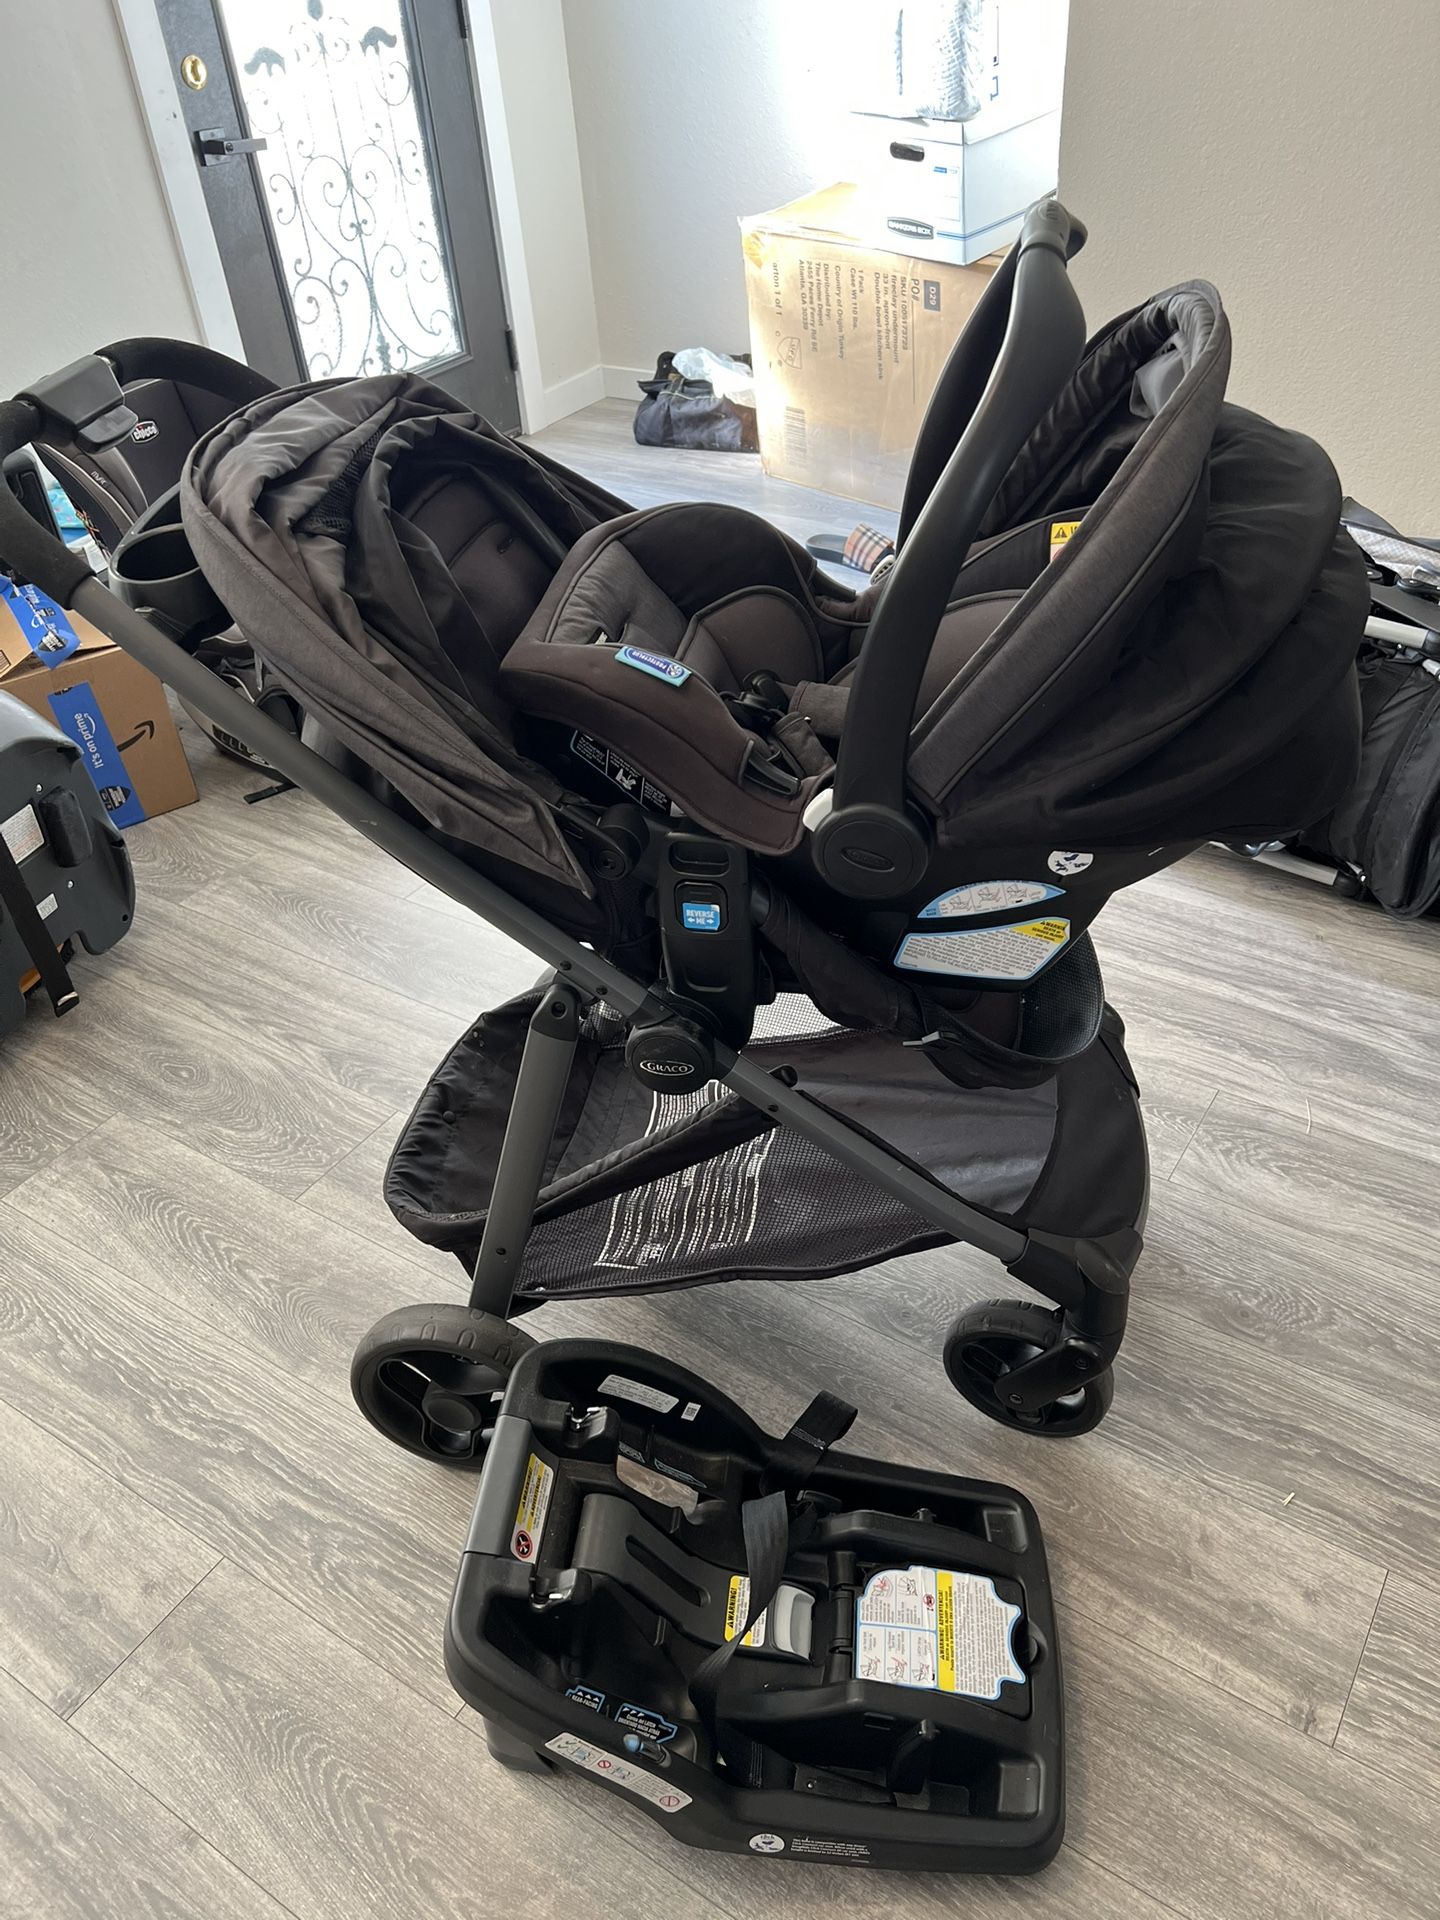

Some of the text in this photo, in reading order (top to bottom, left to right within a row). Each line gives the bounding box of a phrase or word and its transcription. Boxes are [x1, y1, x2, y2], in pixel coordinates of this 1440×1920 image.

[834, 265, 842, 298] Country
[849, 267, 857, 288] Case
[910, 278, 920, 302] PO#
[929, 286, 937, 306] D29
[775, 298, 783, 309] of
[836, 308, 845, 333] Origin
[875, 306, 883, 328] bowl
[883, 299, 891, 350] apron-front
[892, 310, 900, 364] undermount
[74, 712, 104, 769] It's on prime
[686, 910, 715, 919] REVERSE
[695, 917, 706, 925] ME
[647, 1063, 688, 1073] GRACO
[728, 1587, 738, 1621] WARNING!
